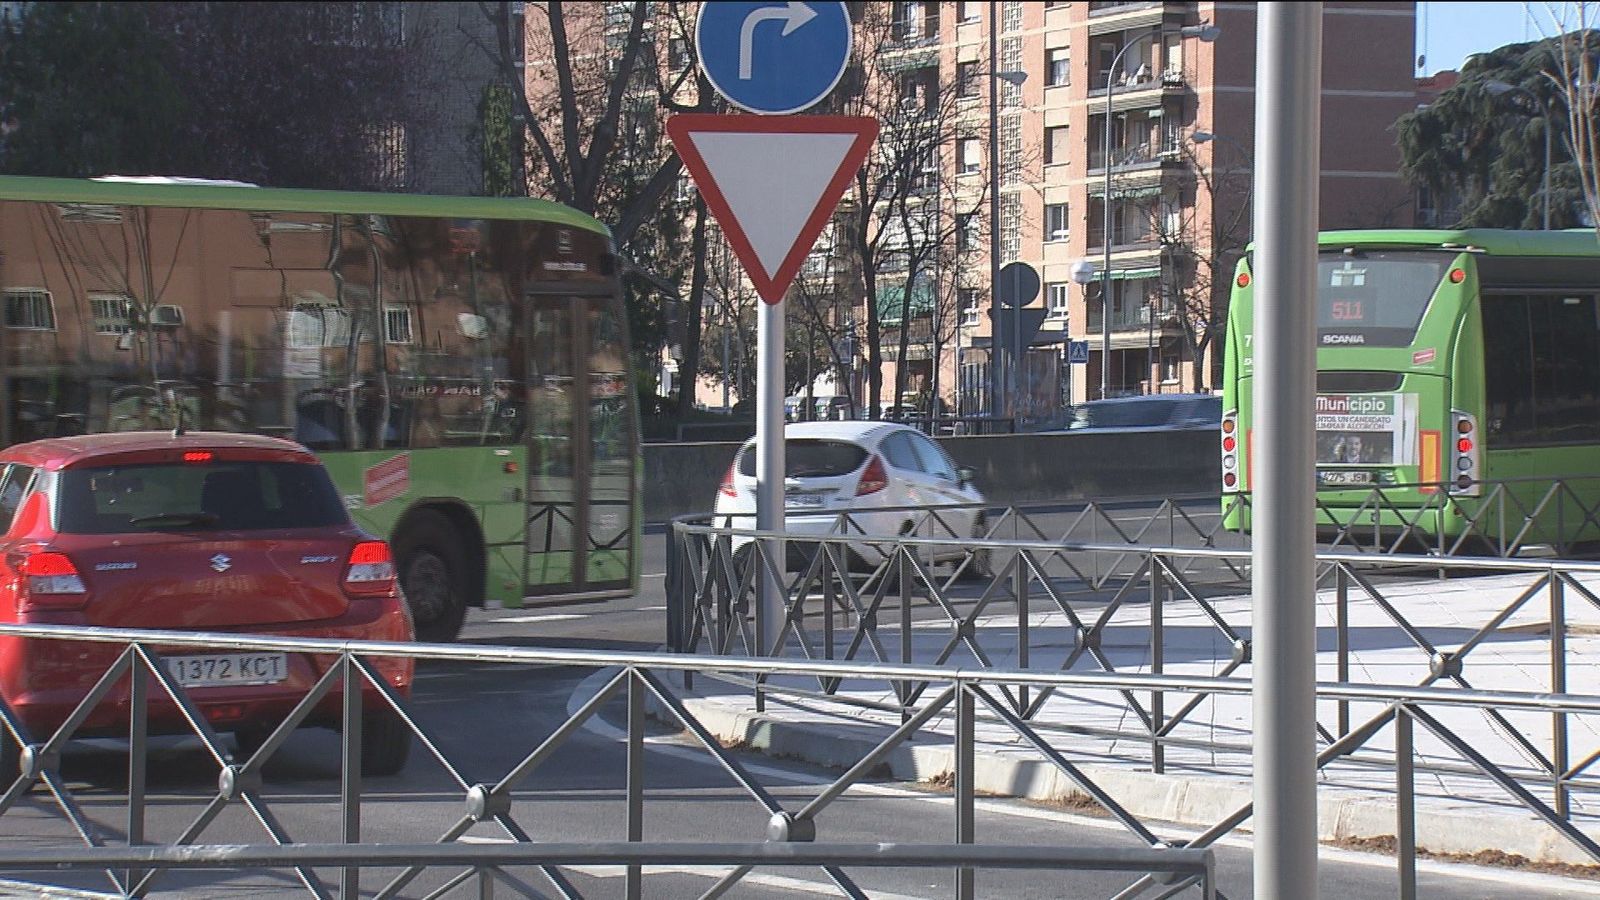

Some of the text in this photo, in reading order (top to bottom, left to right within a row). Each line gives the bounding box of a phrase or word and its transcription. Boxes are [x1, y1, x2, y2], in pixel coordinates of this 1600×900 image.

[1331, 301, 1363, 320] 511
[1322, 334, 1365, 344] SCANIA
[1316, 396, 1387, 414] Municipio
[177, 656, 281, 680] 1372 KCT
